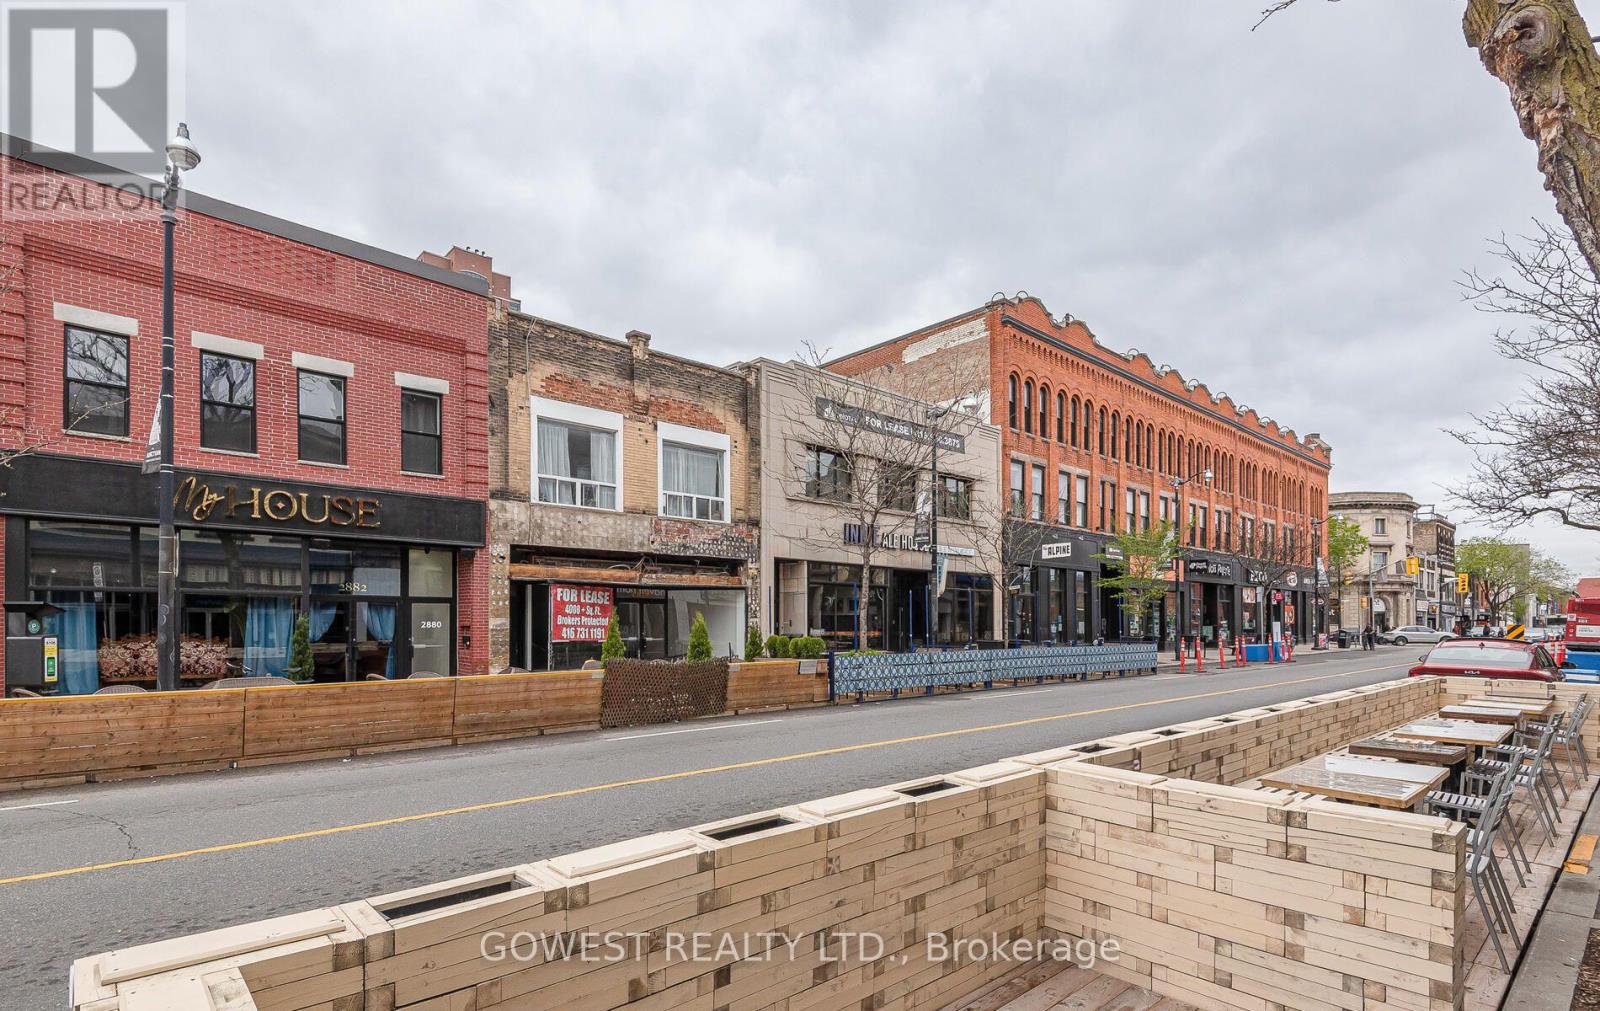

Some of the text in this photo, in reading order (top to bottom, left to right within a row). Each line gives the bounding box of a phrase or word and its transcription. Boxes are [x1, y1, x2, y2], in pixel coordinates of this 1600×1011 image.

[865, 415, 882, 430] FOR
[883, 420, 910, 436] LEASE
[173, 476, 382, 527] My HOUSE
[843, 523, 880, 548] INDE
[881, 532, 898, 549] ALE
[1047, 544, 1070, 556] ALPINE
[338, 582, 368, 592] 2882
[556, 587, 578, 602] FOR
[580, 589, 610, 604] LEASE
[420, 621, 442, 629] 2880
[557, 614, 609, 626] Brokers Protected
[561, 627, 605, 639] 416 731 1191
